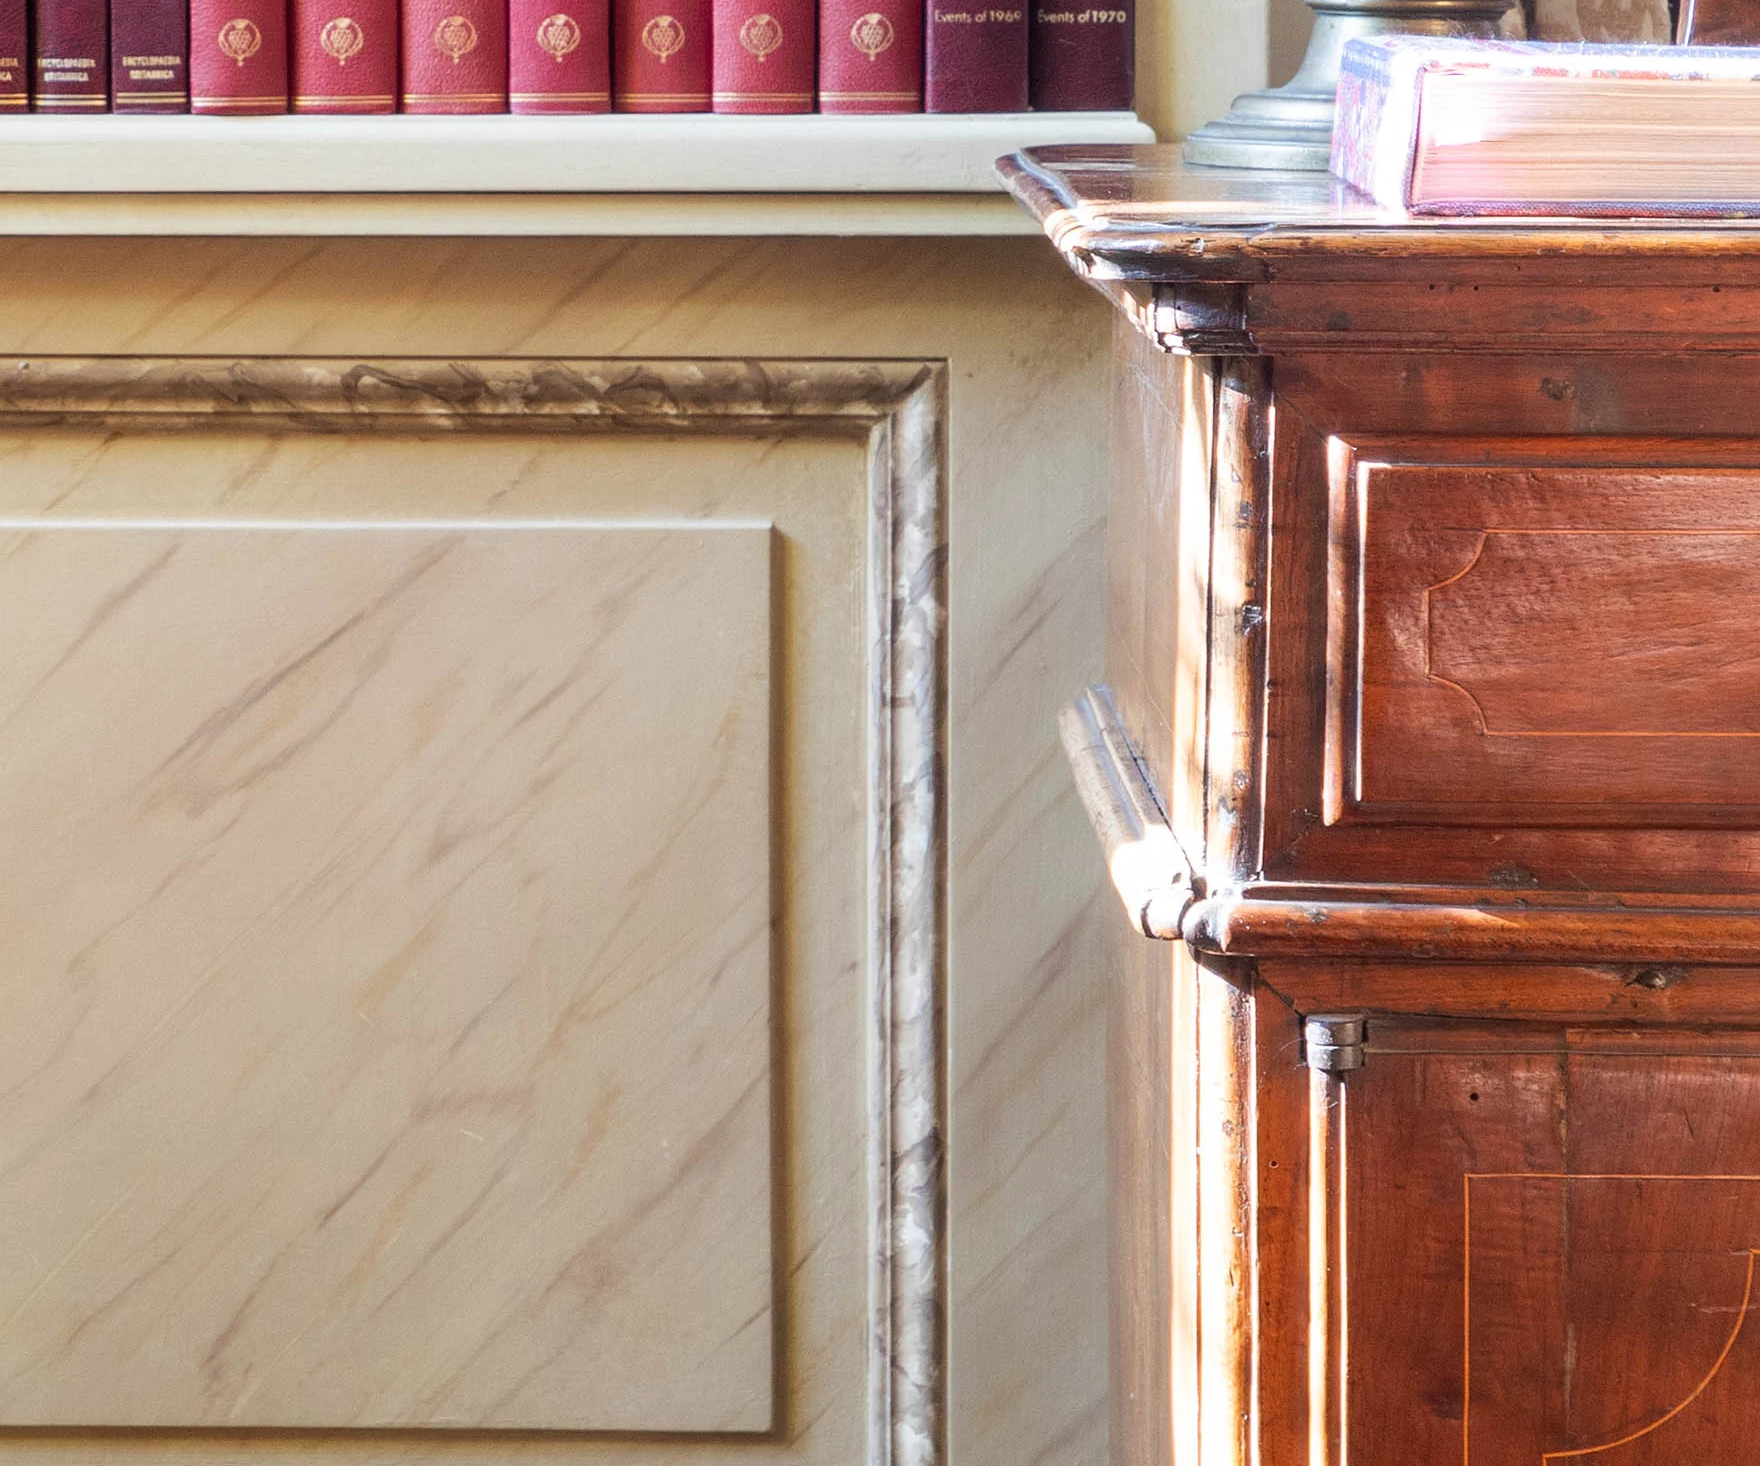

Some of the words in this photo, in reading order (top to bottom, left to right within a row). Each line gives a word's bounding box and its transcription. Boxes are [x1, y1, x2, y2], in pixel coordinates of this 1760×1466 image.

[935, 10, 971, 23] Events
[1038, 10, 1074, 24] Events
[1092, 11, 1126, 24] 1970
